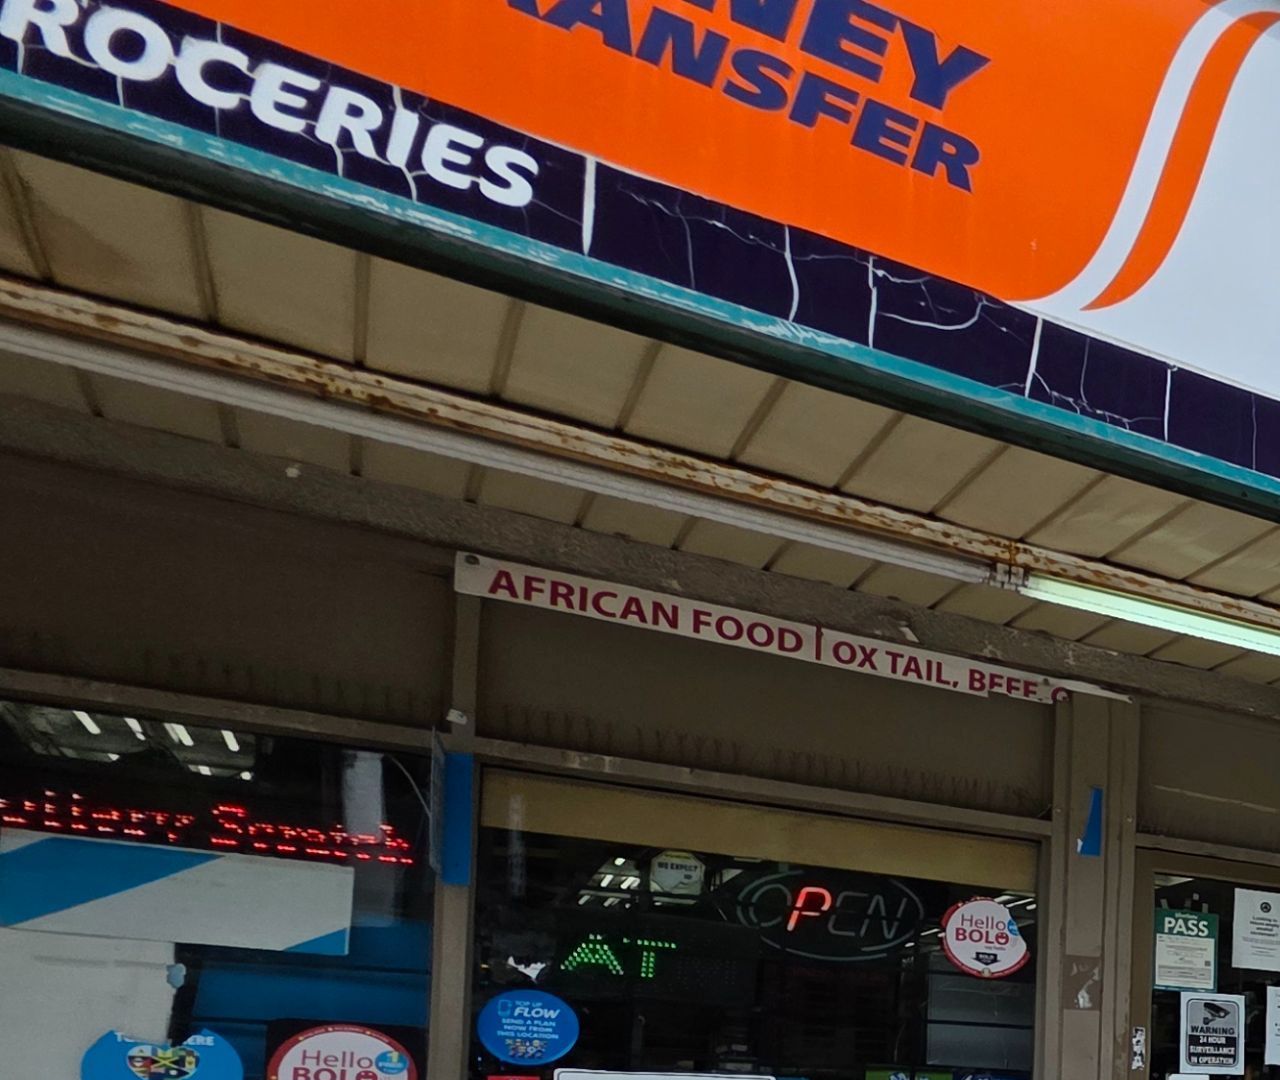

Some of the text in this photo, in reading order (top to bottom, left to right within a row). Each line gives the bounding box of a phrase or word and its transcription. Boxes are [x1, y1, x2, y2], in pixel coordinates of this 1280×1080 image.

[488, 570, 680, 630] AFRICAN
[692, 612, 803, 653] FOOD
[832, 641, 878, 670] OX
[885, 651, 959, 690] TAIL,
[961, 914, 1006, 931] Hello
[1163, 916, 1209, 937] PASS
[513, 1007, 561, 1019] FLOW
[1190, 1025, 1235, 1035] WARNING
[1208, 1036, 1226, 1044] HOUR
[1189, 1046, 1235, 1055] SURVEILLANCE
[301, 1049, 373, 1069] Hello
[1199, 1056, 1234, 1065] OPERATION
